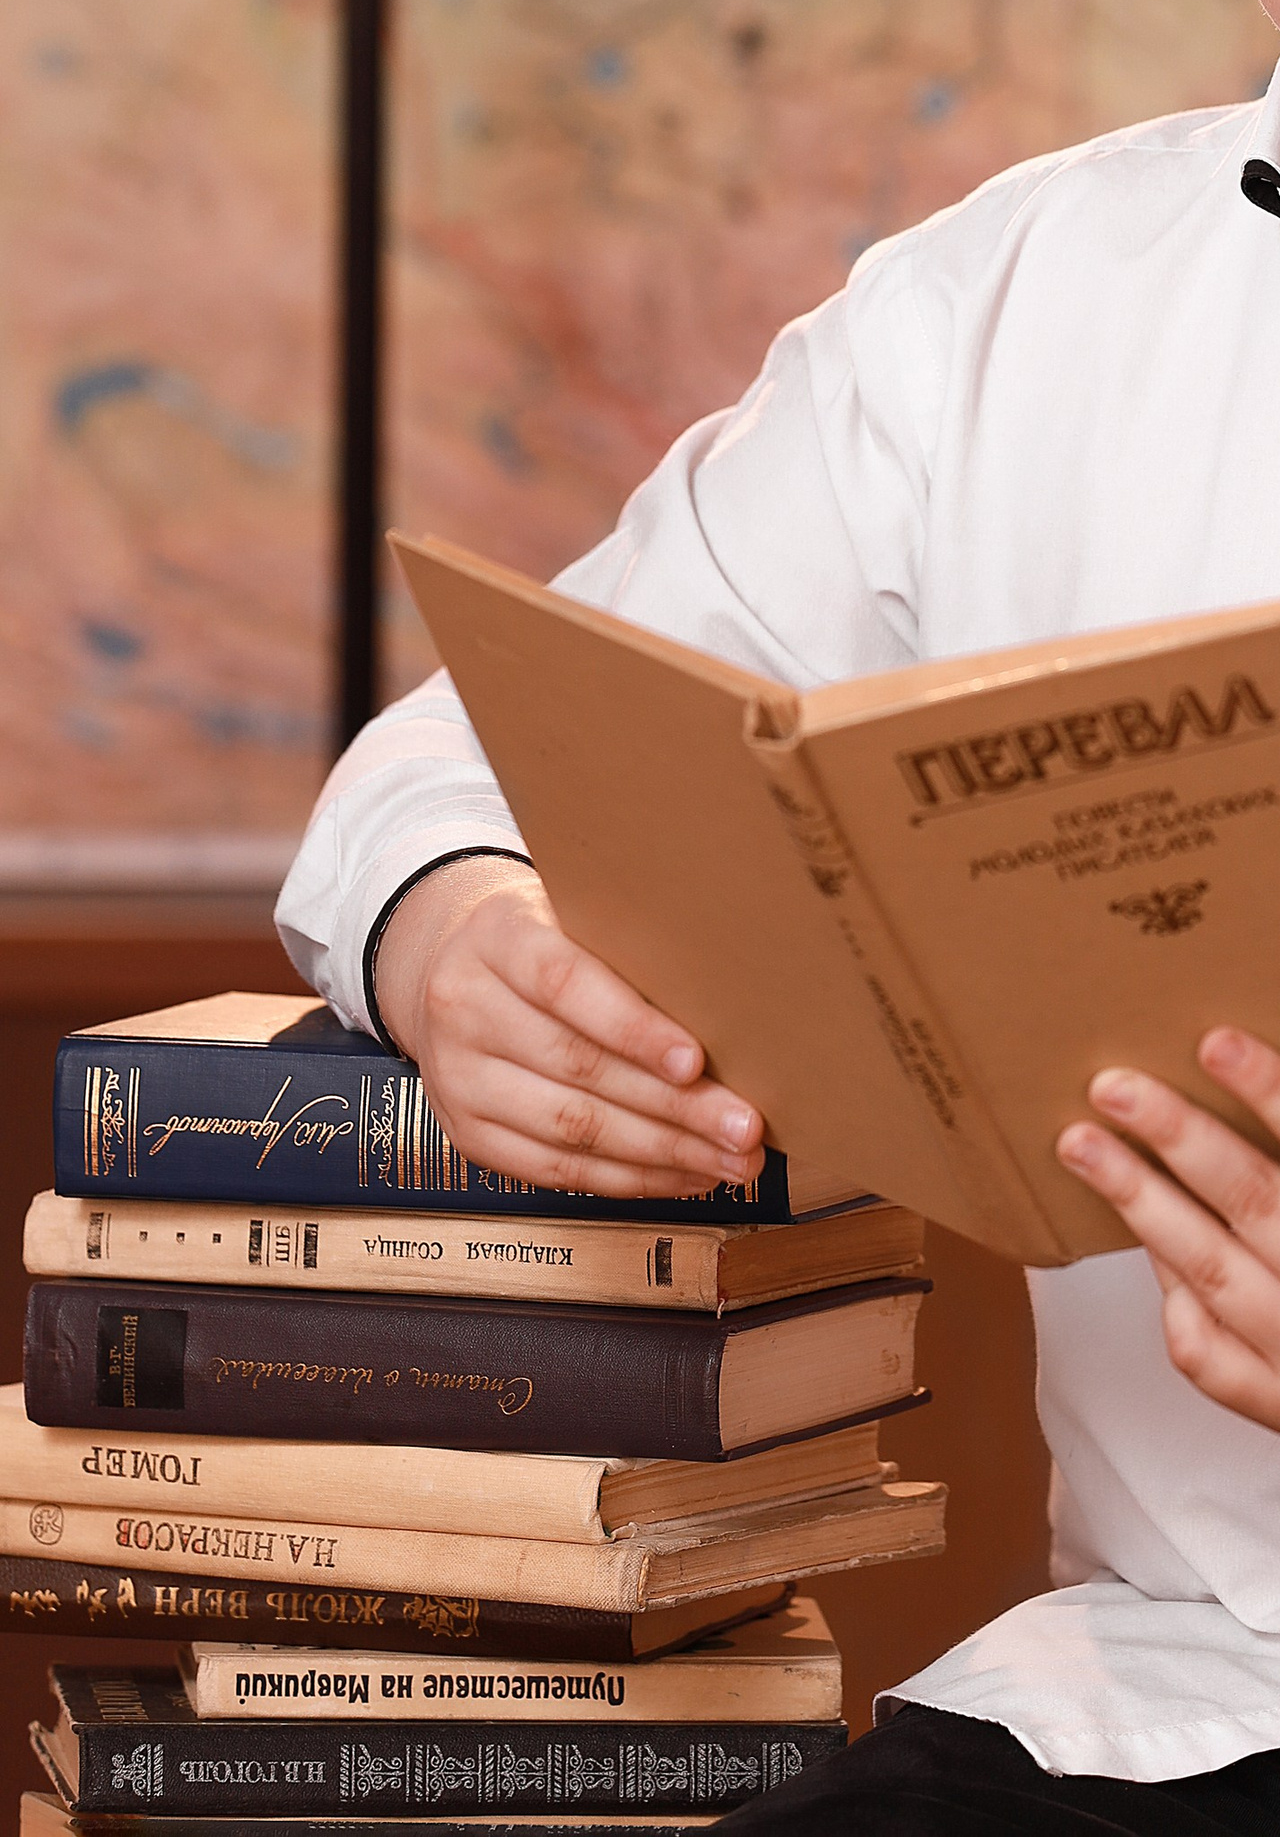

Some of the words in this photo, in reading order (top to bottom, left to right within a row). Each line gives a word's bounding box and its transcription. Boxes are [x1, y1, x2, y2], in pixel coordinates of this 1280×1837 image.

[895, 672, 1277, 806] ПЕРЕВАЛ
[274, 1225, 291, 1263] ШБ
[362, 1234, 444, 1260] СОЛНЦА
[465, 1240, 574, 1266] КЛАДОВАЯ
[121, 1314, 140, 1408] БЕЛИНСКИЙ
[211, 1356, 374, 1395] классиках
[383, 1368, 400, 1388] о
[409, 1366, 533, 1415] Статьи
[81, 1446, 202, 1486] ГОМЕР
[153, 1584, 250, 1620] ВЕРН
[265, 1591, 386, 1625] ЖЮЛЬ
[234, 1672, 370, 1706] Маврикий
[380, 1673, 414, 1699] на
[422, 1671, 626, 1706] Путешествие
